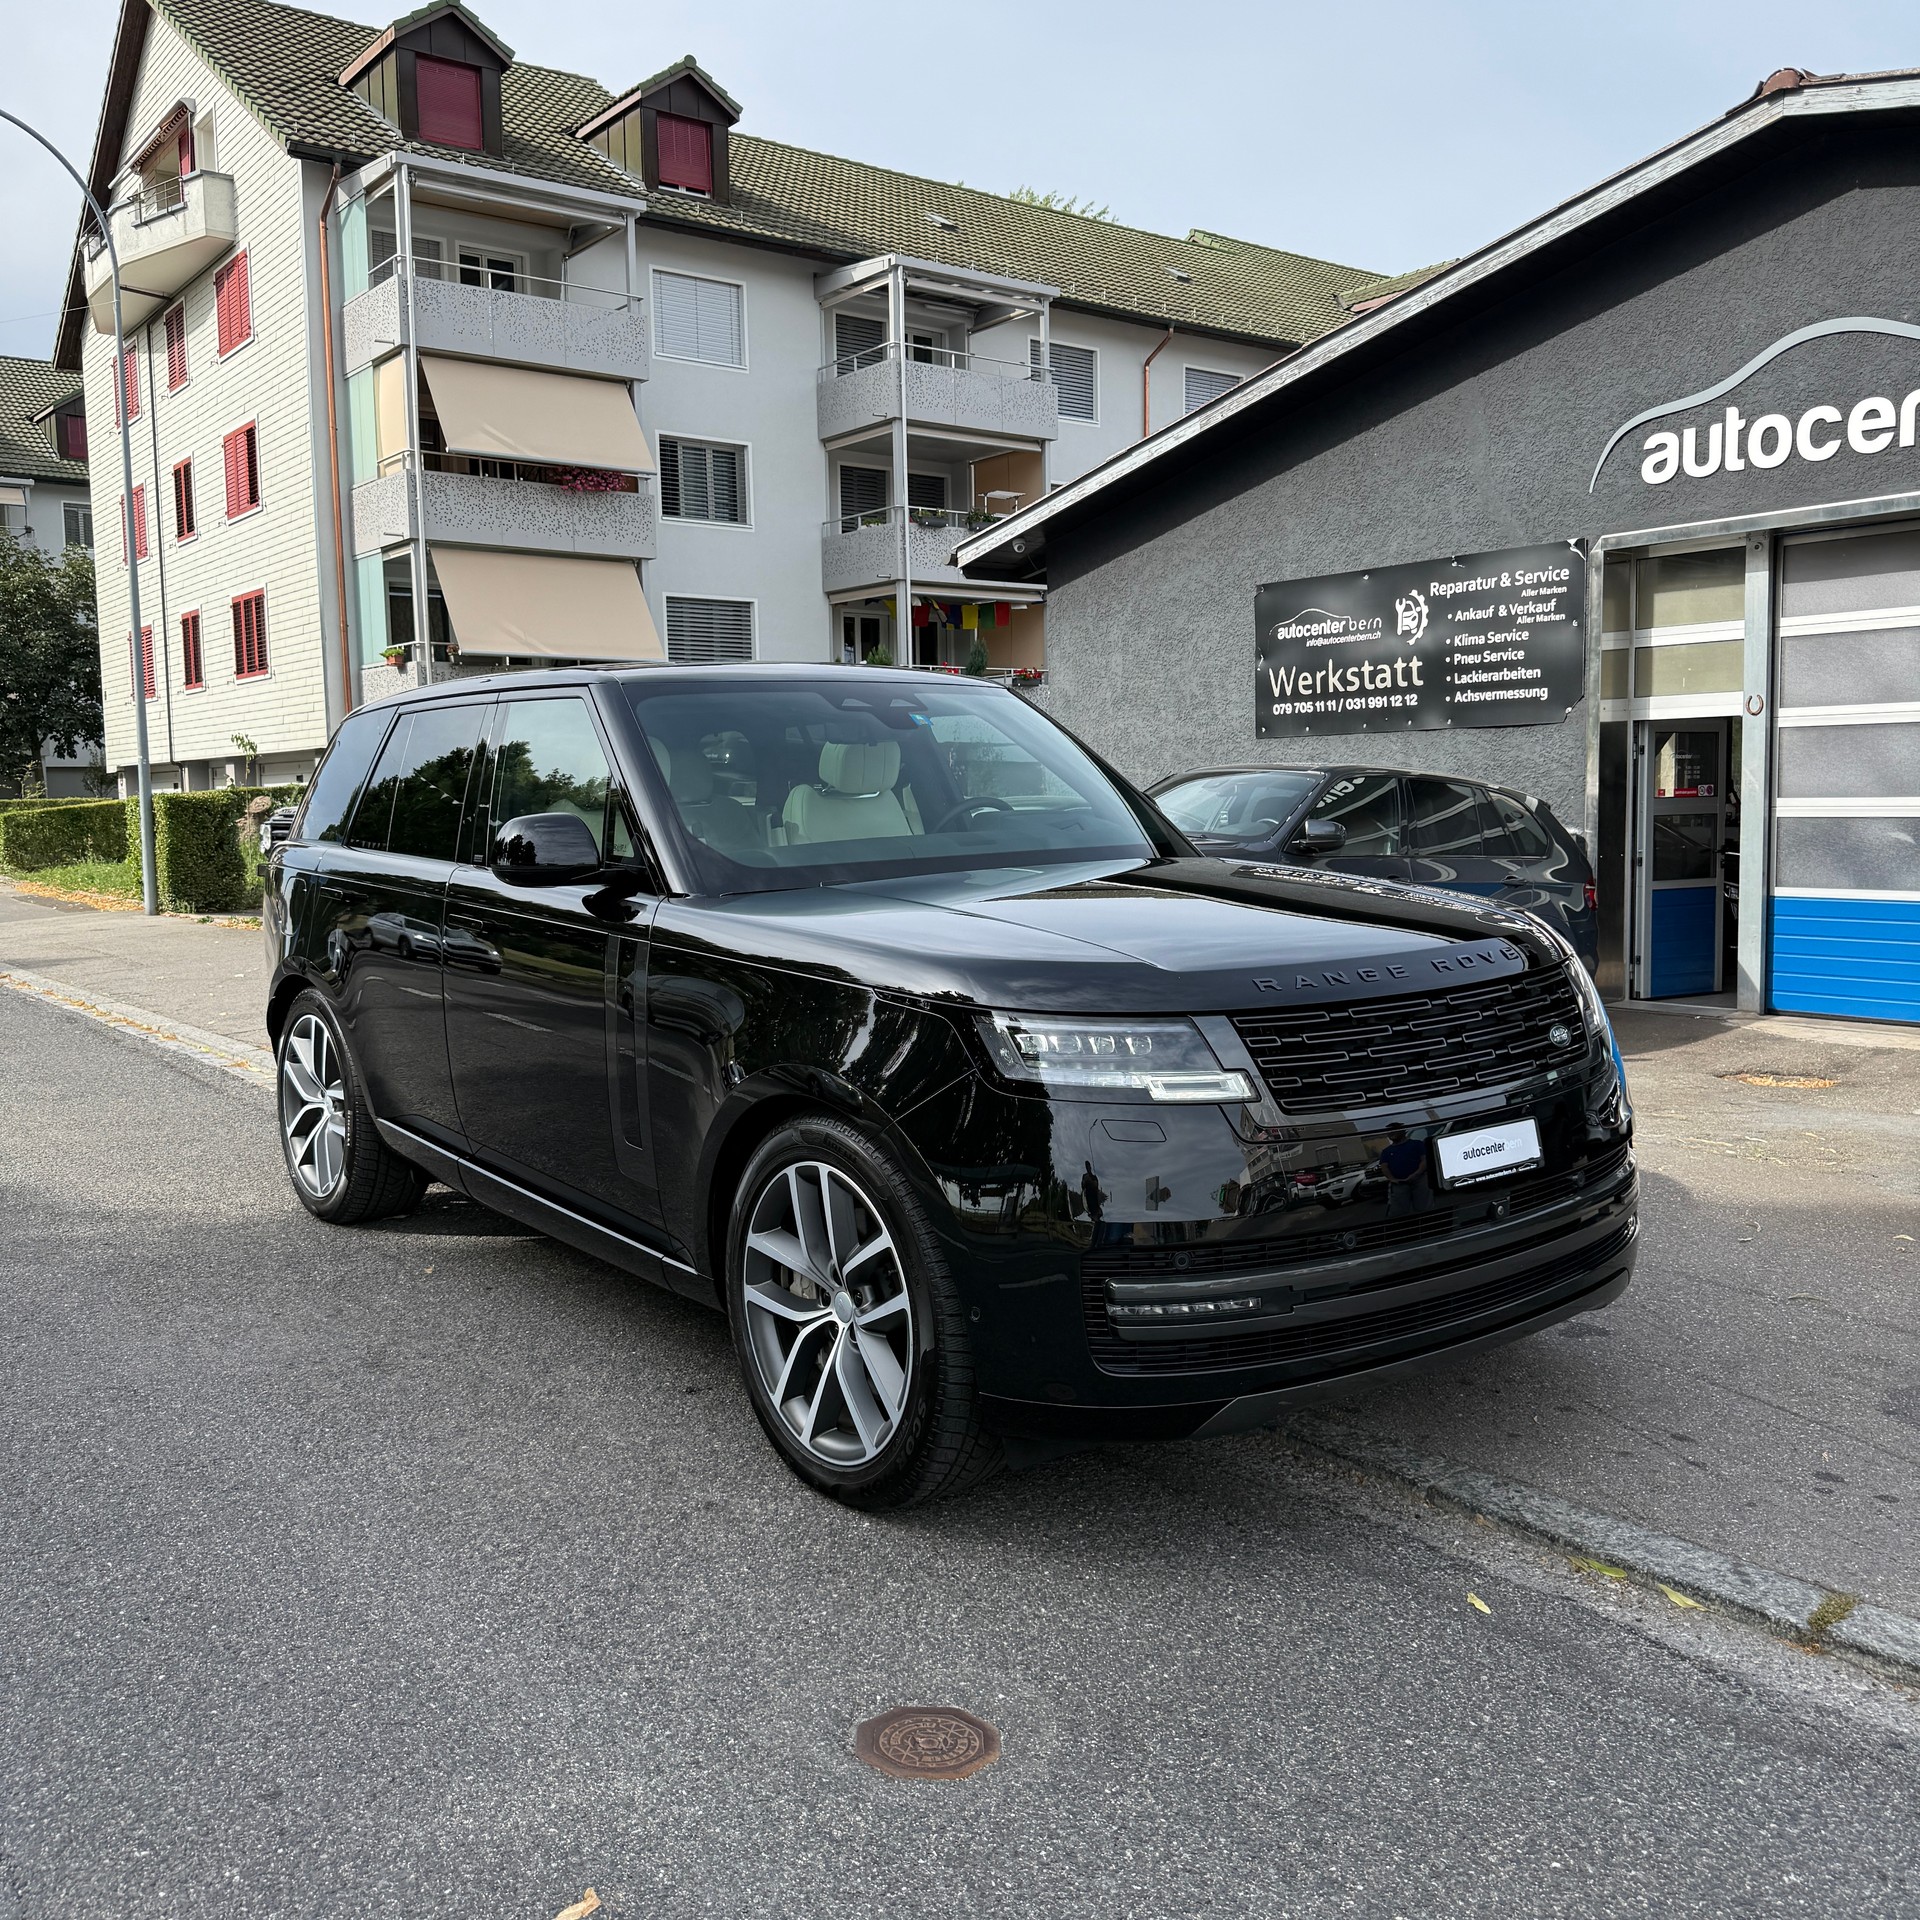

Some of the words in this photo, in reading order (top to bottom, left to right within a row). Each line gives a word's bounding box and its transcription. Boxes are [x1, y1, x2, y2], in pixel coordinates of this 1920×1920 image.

[1430, 576, 1498, 599] Reparatur
[1500, 572, 1512, 588] &
[1514, 565, 1570, 586] Service
[1520, 588, 1539, 598] Aller
[1539, 585, 1568, 596] Marken
[1454, 605, 1495, 622] Ankauf
[1498, 604, 1508, 617] &
[1509, 598, 1557, 616] Verkauf
[1516, 615, 1536, 625] Aller
[1536, 613, 1566, 623] Marken
[1277, 619, 1346, 640] autocenter
[1348, 616, 1383, 632] bern
[1454, 633, 1486, 647] Klima
[1487, 628, 1530, 644] Service
[1306, 630, 1382, 647] info@autocenterbern.ch
[1454, 653, 1482, 665] Pneu
[1483, 648, 1525, 663] Service
[1269, 655, 1424, 698] Werkstatt
[1454, 666, 1541, 685] Lackierarbeiten
[1273, 703, 1293, 715] 079
[1294, 701, 1314, 714] 705
[1315, 700, 1325, 712] 11
[1326, 699, 1337, 711] 11
[1338, 698, 1344, 712] /
[1346, 697, 1366, 710] 031
[1368, 695, 1388, 708] 991
[1390, 694, 1403, 707] 12
[1405, 694, 1418, 706] 12
[1454, 687, 1549, 703] Achsvermessung
[1252, 964, 1410, 992] RANGE
[1431, 943, 1533, 973] ROVER
[1462, 1141, 1506, 1161] autocenter
